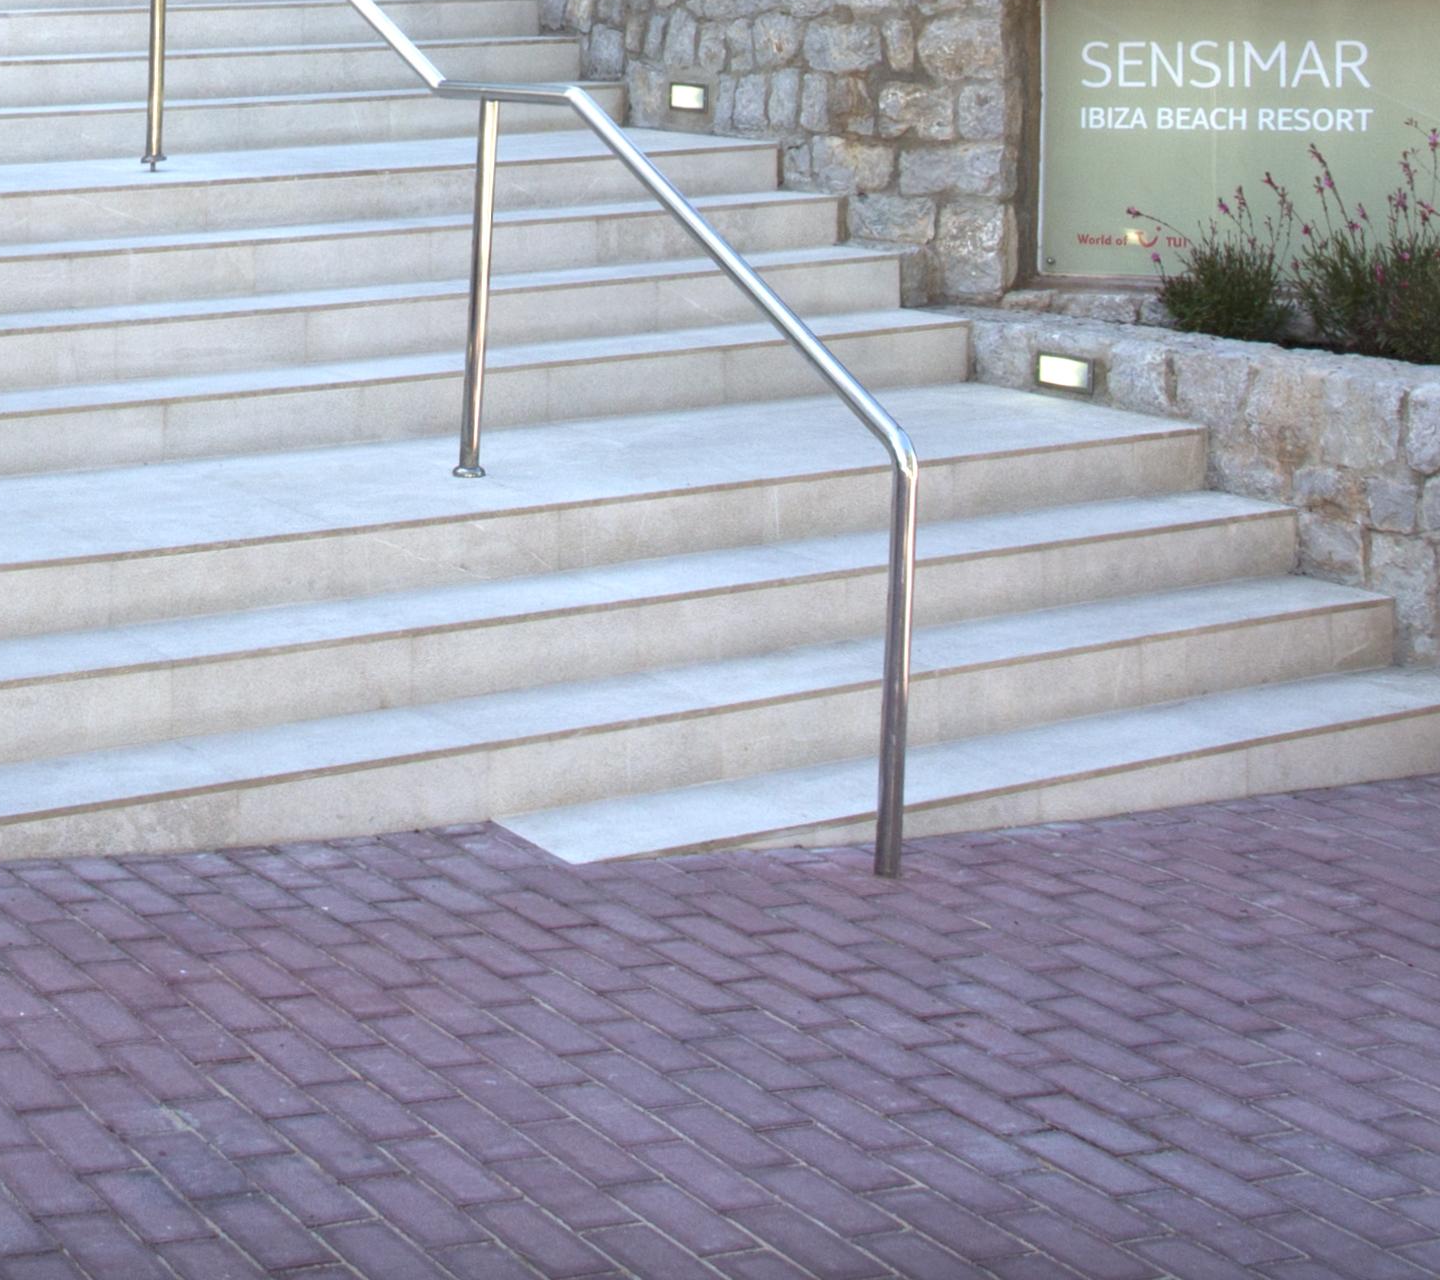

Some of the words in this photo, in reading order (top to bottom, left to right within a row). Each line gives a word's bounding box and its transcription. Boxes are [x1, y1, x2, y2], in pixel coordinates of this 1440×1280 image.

[1080, 39, 1372, 89] SENSIMAR
[1080, 106, 1148, 130] IBIZA
[1156, 106, 1247, 131] BEACH
[1258, 107, 1374, 132] RESORT
[1077, 233, 1112, 246] World
[1115, 234, 1128, 246] of
[1166, 236, 1187, 248] TUI
